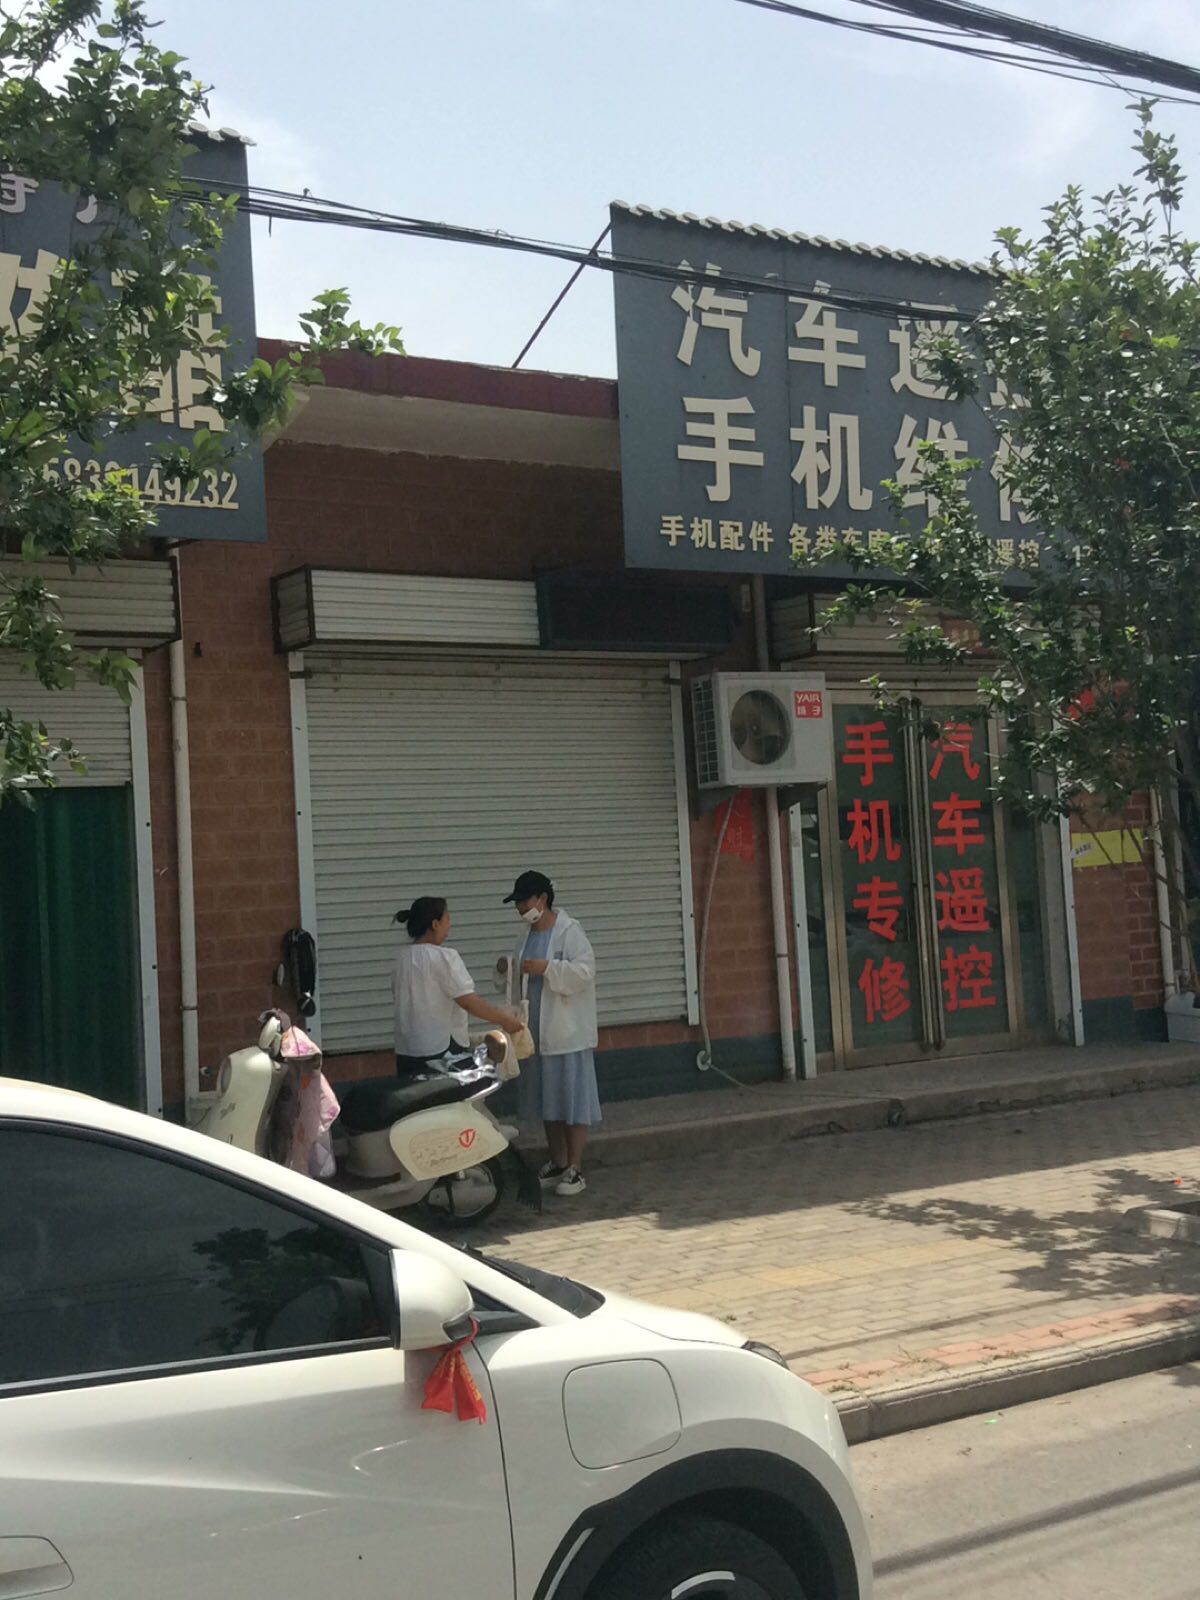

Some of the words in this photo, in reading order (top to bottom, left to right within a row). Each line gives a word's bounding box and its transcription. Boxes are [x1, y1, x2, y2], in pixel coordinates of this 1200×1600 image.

[659, 514, 774, 552] 手机配件
[842, 720, 912, 1024] 手机专修
[928, 719, 997, 1013] 汽车遥控
